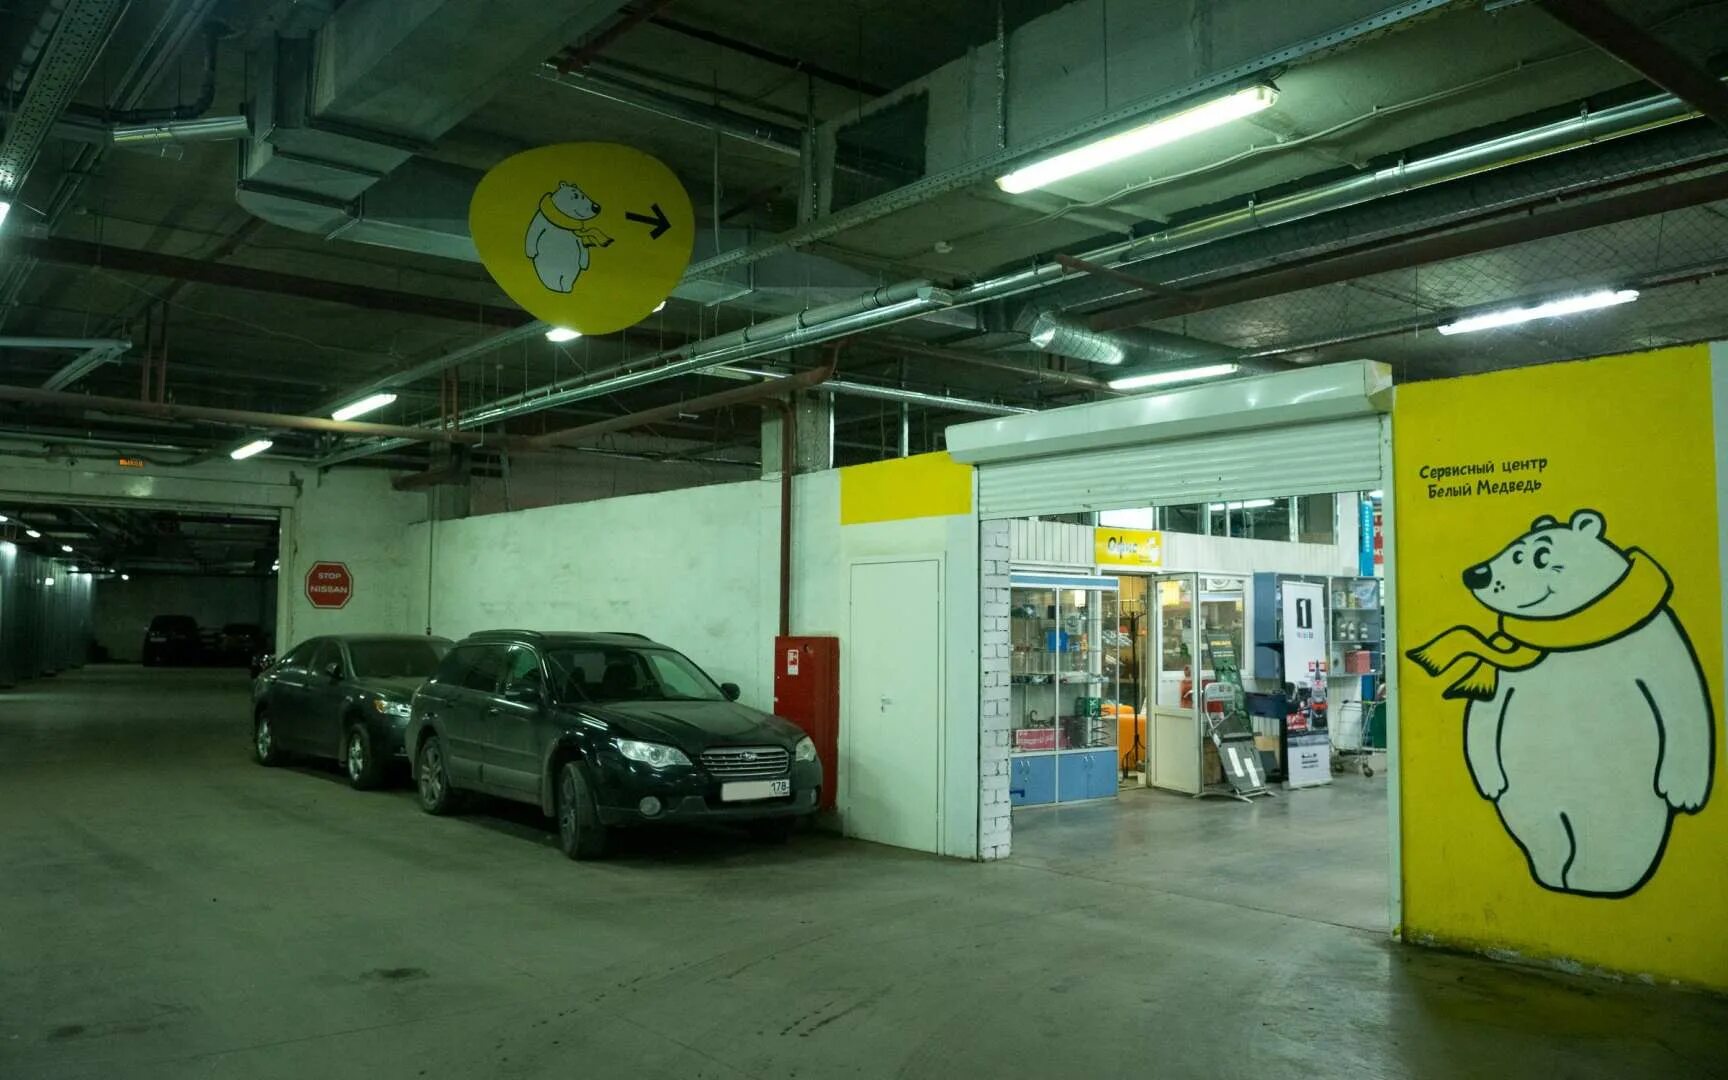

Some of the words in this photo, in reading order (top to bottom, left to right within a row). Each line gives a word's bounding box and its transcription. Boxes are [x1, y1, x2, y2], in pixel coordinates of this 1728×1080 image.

[1419, 461, 1495, 481] Сервисный
[1501, 458, 1548, 473] центр
[1428, 483, 1472, 499] Белый
[1476, 479, 1542, 495] Медведь
[318, 572, 342, 580] STOP
[310, 585, 348, 593] NISSAN
[770, 781, 786, 792] 178
